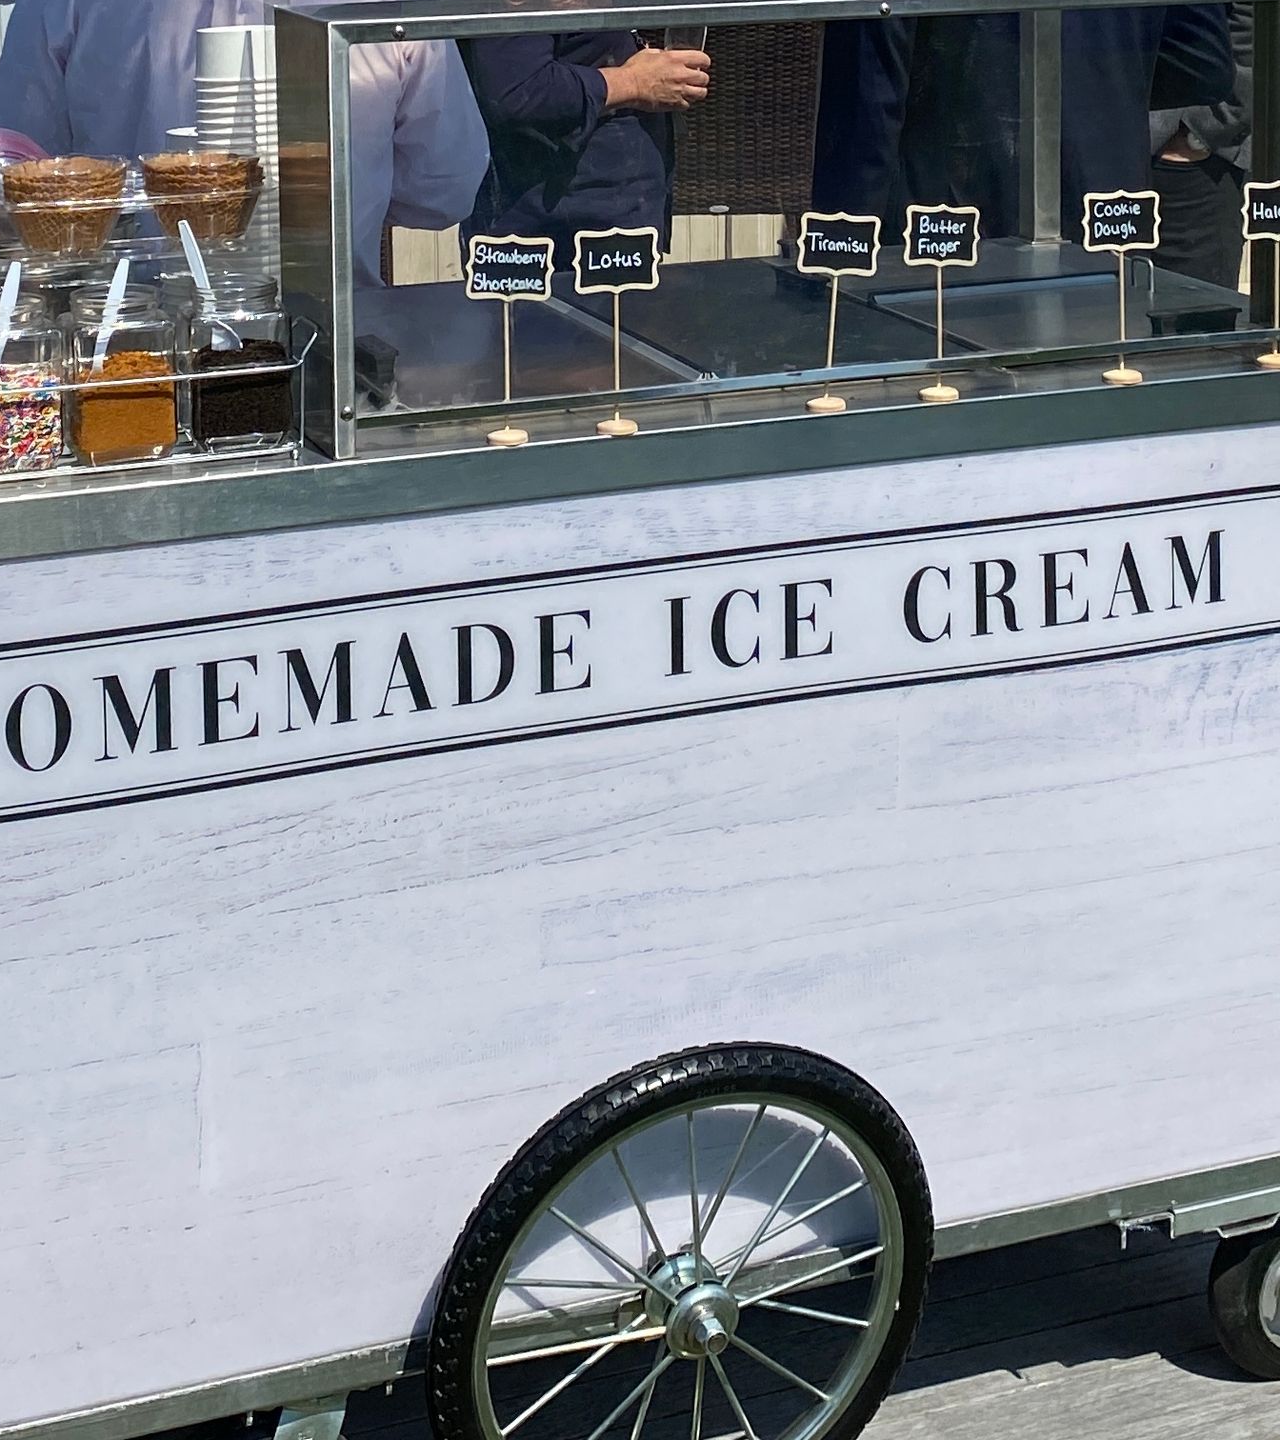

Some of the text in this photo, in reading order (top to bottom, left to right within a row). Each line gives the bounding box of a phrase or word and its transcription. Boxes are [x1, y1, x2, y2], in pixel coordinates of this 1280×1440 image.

[1093, 201, 1141, 218] Cookie
[919, 215, 967, 235] Butter
[1094, 220, 1137, 239] Dough
[806, 232, 869, 254] Tiramisu
[918, 237, 961, 258] Finger
[475, 244, 546, 269] Strawberry
[588, 250, 642, 271] Lotus
[473, 272, 545, 292] Shortcake
[663, 577, 834, 677] ICE
[902, 528, 1227, 644] CREAM
